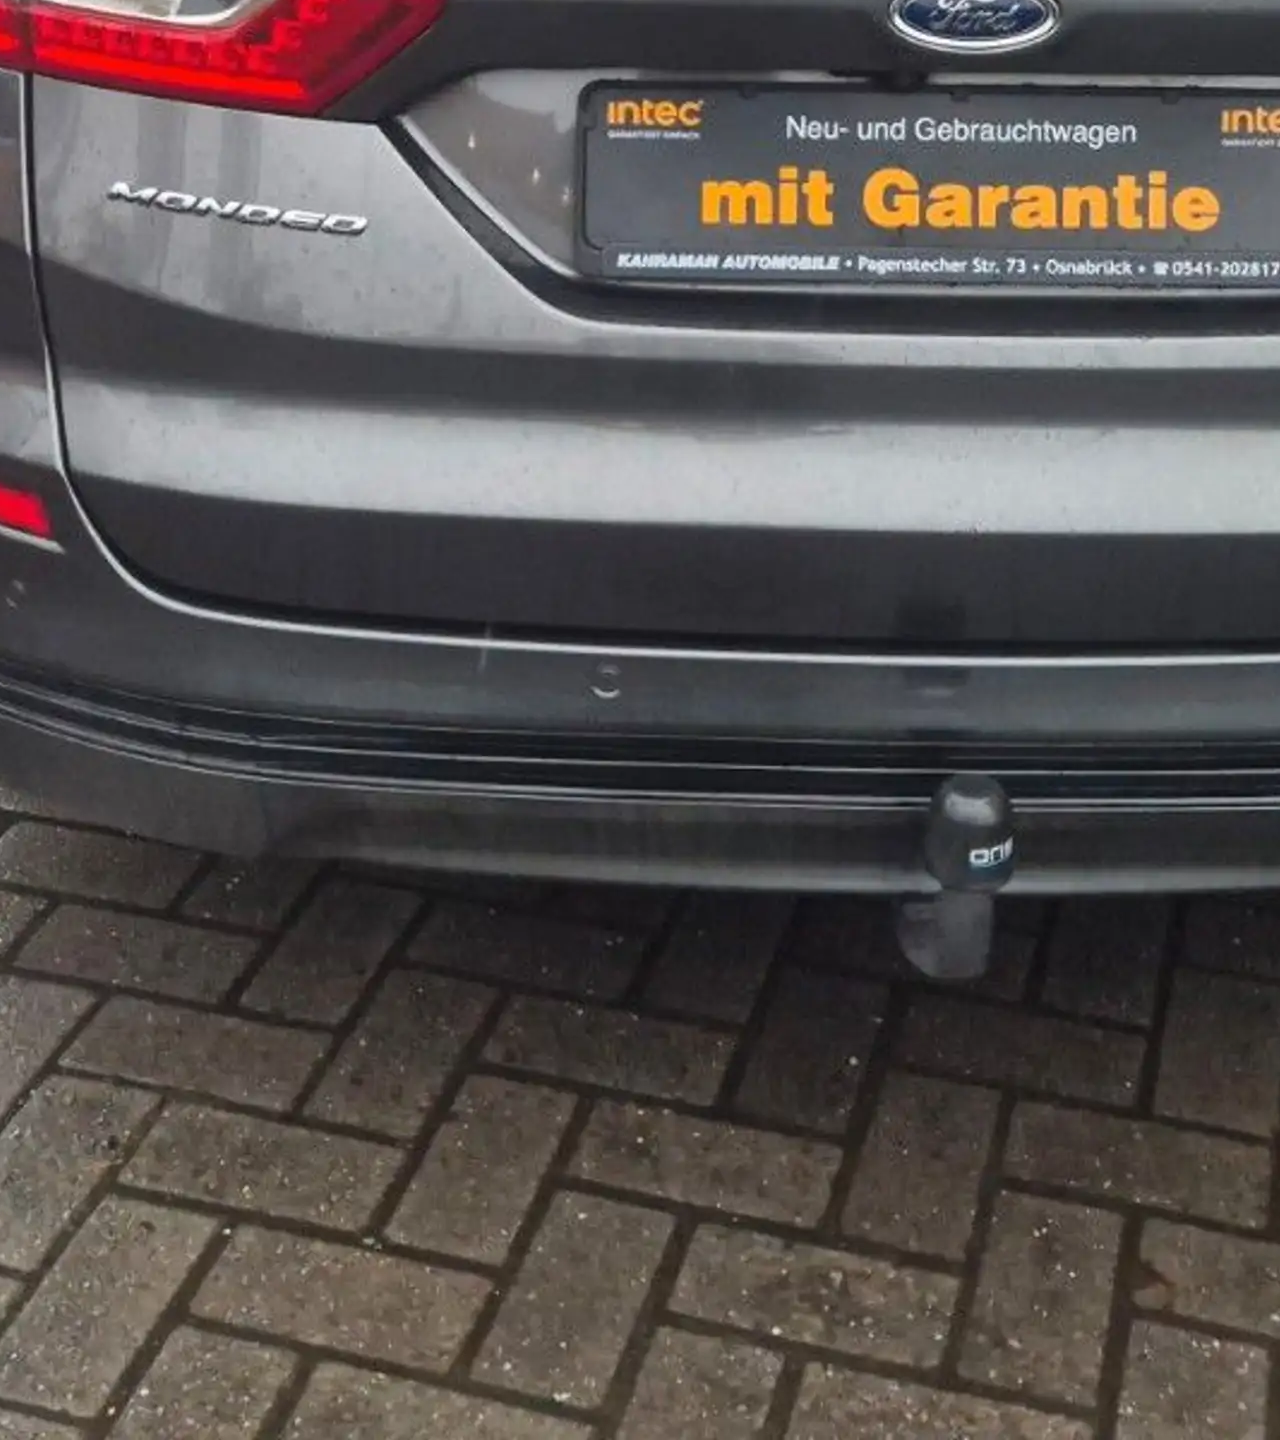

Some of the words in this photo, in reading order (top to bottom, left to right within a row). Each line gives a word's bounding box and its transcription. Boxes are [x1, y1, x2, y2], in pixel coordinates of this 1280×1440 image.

[606, 98, 704, 127] intec
[786, 115, 850, 141] Neu-
[857, 116, 907, 142] und
[914, 115, 1139, 150] Gebrauchtwagen
[107, 181, 368, 236] MONDEO
[701, 166, 834, 226] mit
[862, 166, 1221, 232] Garantie
[616, 253, 721, 270] KAHRAMAN
[722, 254, 840, 271] AUTOMOBILE
[857, 255, 968, 275] Pagenstecher
[971, 257, 1001, 274] Str.
[1005, 258, 1027, 274] 73
[1045, 257, 1133, 276] Osnabrück
